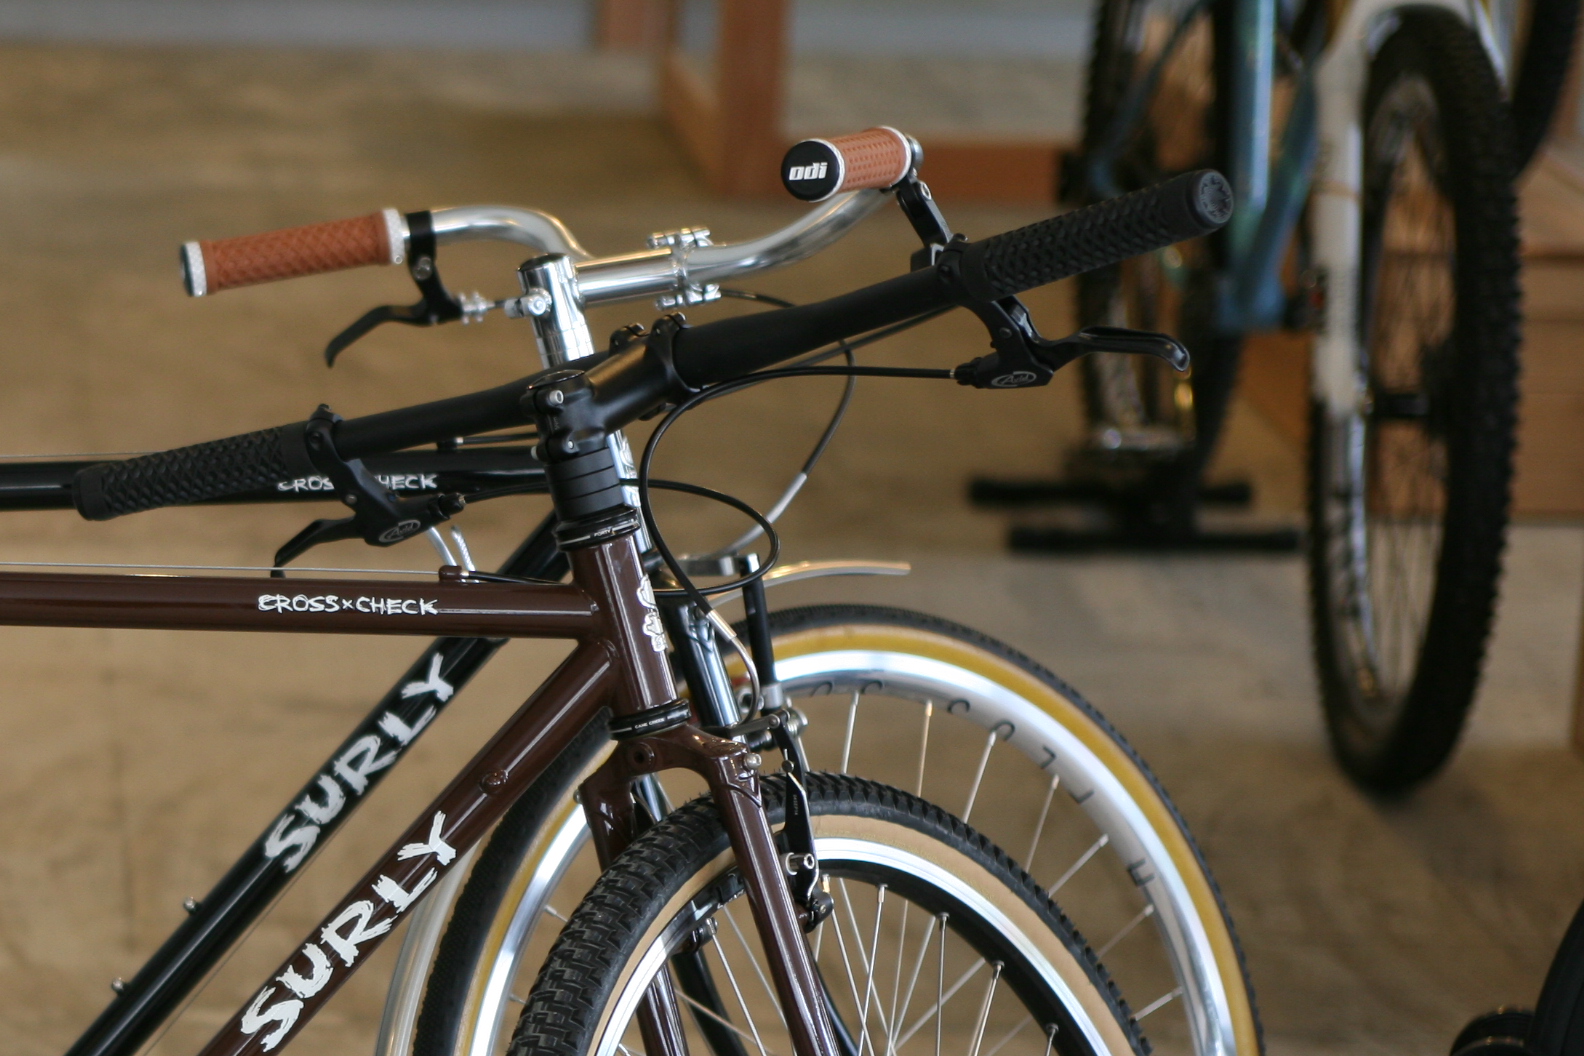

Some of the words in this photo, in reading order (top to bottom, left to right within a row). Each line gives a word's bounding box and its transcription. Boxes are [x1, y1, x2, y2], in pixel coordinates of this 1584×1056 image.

[789, 162, 828, 181] odi
[265, 652, 454, 874] SURLY
[240, 810, 457, 1053] SURLY
